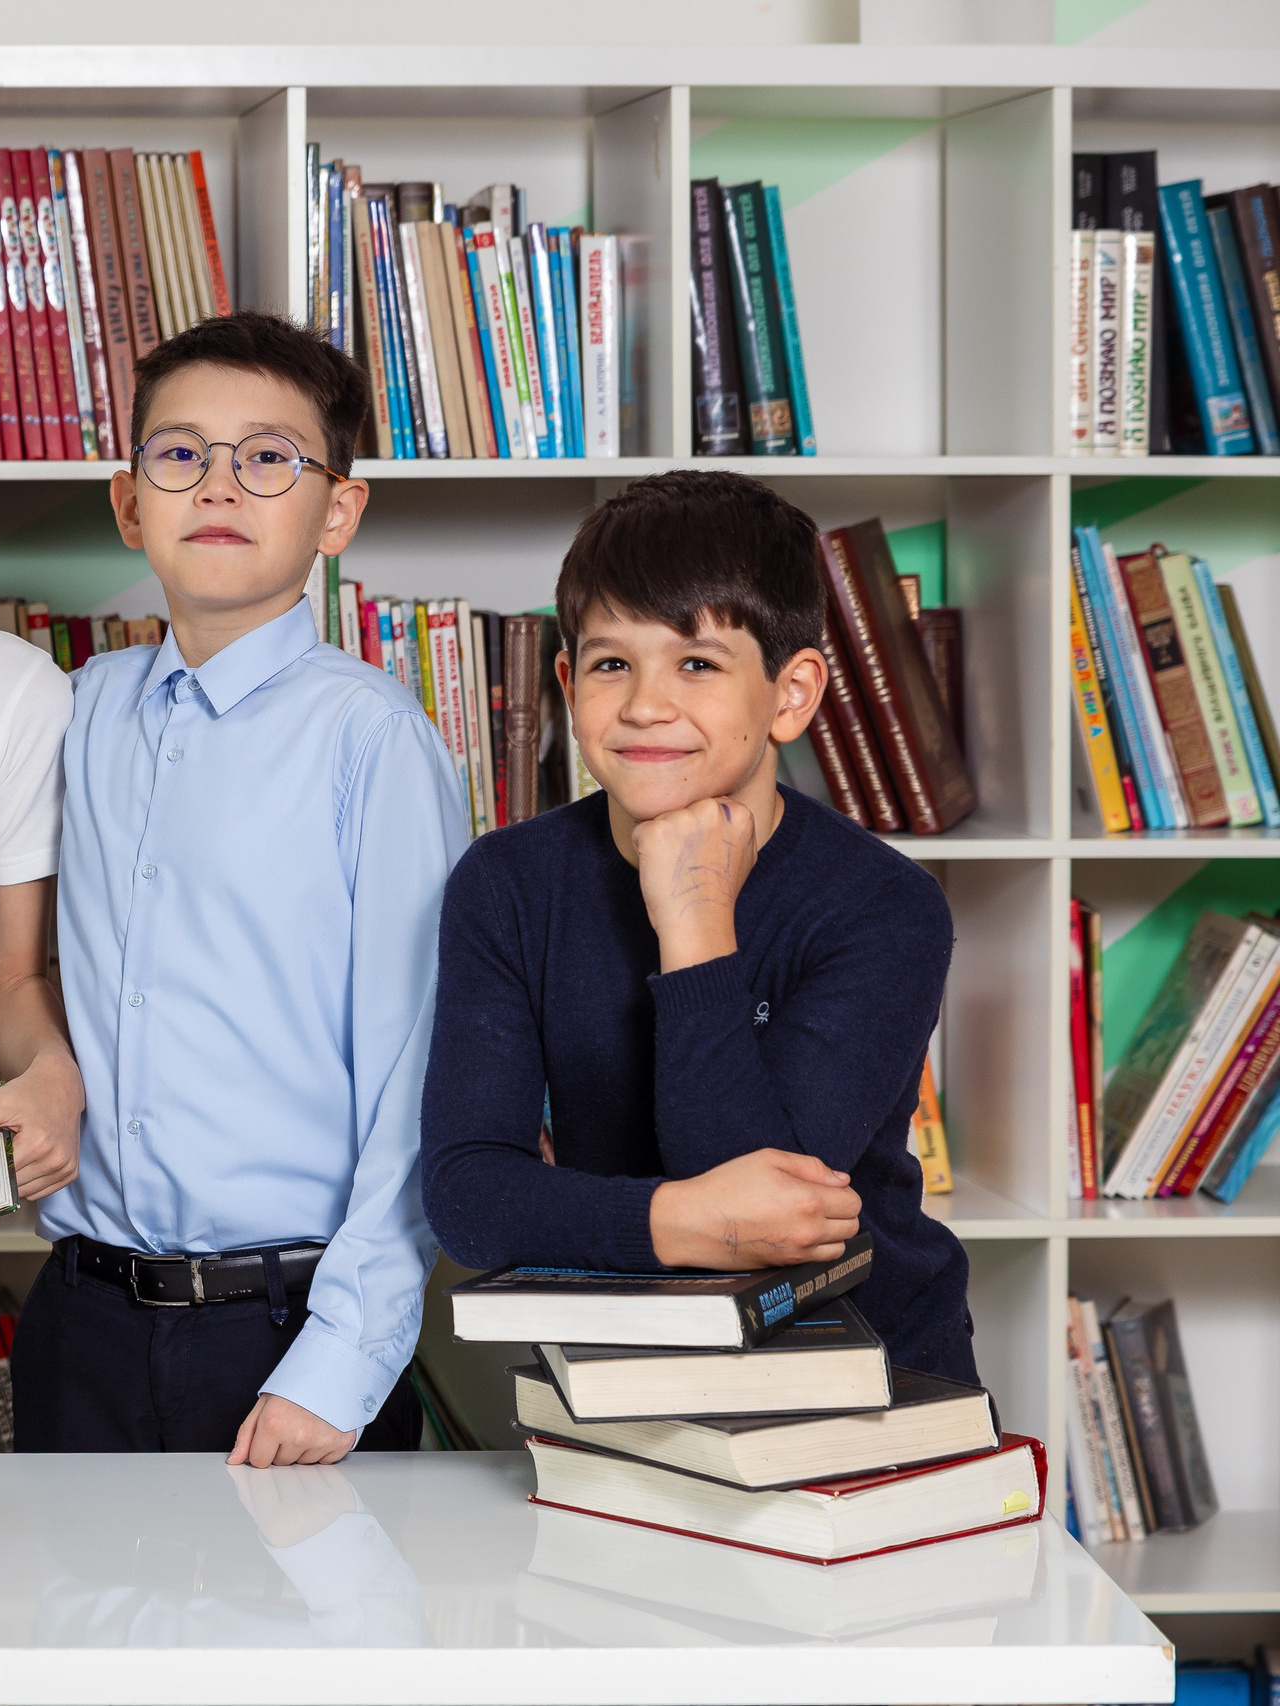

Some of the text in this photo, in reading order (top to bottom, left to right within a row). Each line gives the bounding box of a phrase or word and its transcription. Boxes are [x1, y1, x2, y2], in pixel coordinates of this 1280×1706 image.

[587, 300, 603, 344] БЕЛЫЙ
[1096, 276, 1116, 434] Я ПОЗНАЮ МИР
[1125, 337, 1147, 421] ПОЗНАЮ
[1124, 428, 1145, 441] Я
[1070, 632, 1104, 738] ШКОЛЬНИКА
[759, 1282, 792, 1310] ИСТОРИЯ
[795, 1280, 814, 1305] ДЕТЕЙ
[814, 1273, 827, 1291] ДЛЯ
